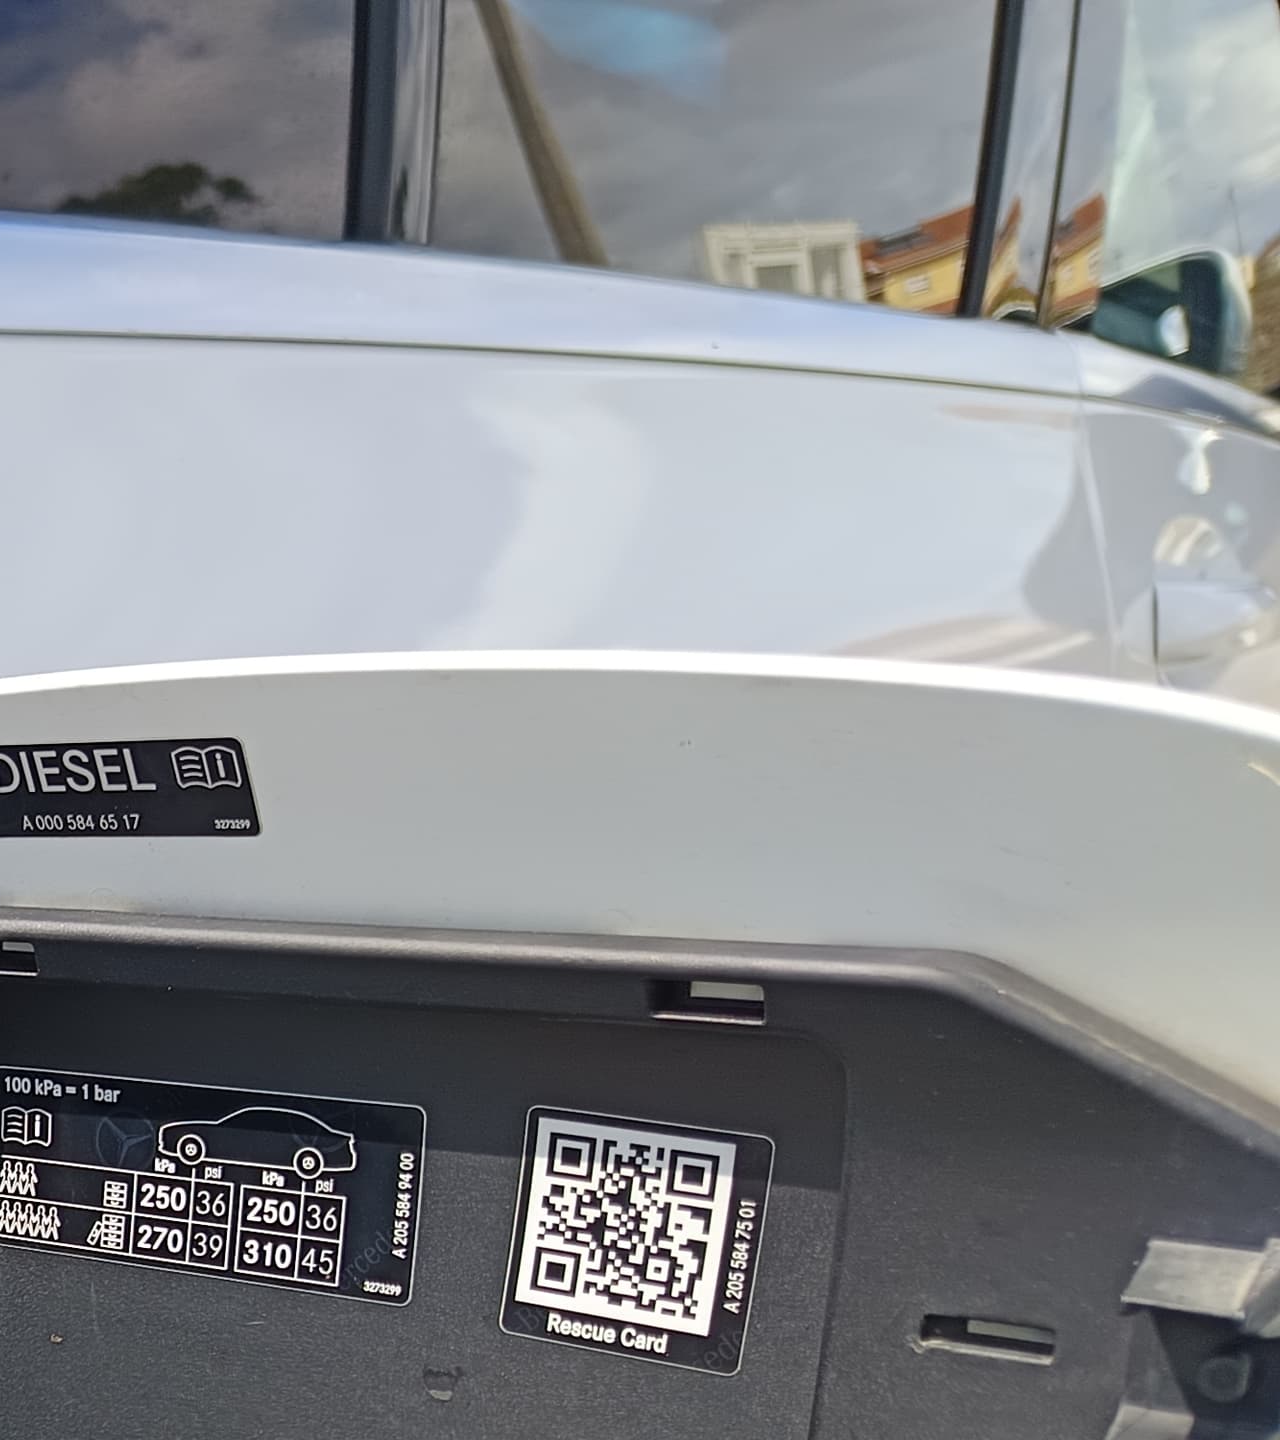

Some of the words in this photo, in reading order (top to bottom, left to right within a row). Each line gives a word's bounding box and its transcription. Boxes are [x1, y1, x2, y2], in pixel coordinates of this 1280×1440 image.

[22, 815, 34, 831] A
[35, 814, 64, 831] 000
[67, 814, 95, 830] 584
[99, 814, 119, 830] 65
[122, 813, 141, 830] 17
[4, 1076, 31, 1095] 100
[34, 1079, 62, 1098] kPa
[82, 1084, 89, 1101] 1
[94, 1084, 121, 1103] bar
[399, 1152, 415, 1171] 00
[154, 1158, 176, 1174] kPa
[204, 1165, 223, 1182] psi
[262, 1171, 285, 1188] kPa
[315, 1177, 334, 1194] psi
[398, 1173, 413, 1190] 94
[139, 1183, 188, 1213] 250
[197, 1188, 226, 1218] 36
[245, 1197, 297, 1227] 250
[304, 1203, 338, 1233] 36
[395, 1193, 412, 1218] 584
[738, 1200, 757, 1219] 01
[392, 1220, 409, 1246] 205
[734, 1221, 754, 1240] 75
[136, 1225, 184, 1255] 270
[192, 1231, 223, 1260] 39
[242, 1239, 293, 1270] 310
[301, 1246, 335, 1277] 45
[392, 1248, 407, 1259] A
[730, 1242, 750, 1270] 584
[725, 1271, 745, 1300] 205
[723, 1302, 741, 1314] A
[547, 1312, 616, 1343] Rescue
[620, 1328, 668, 1354] Card
